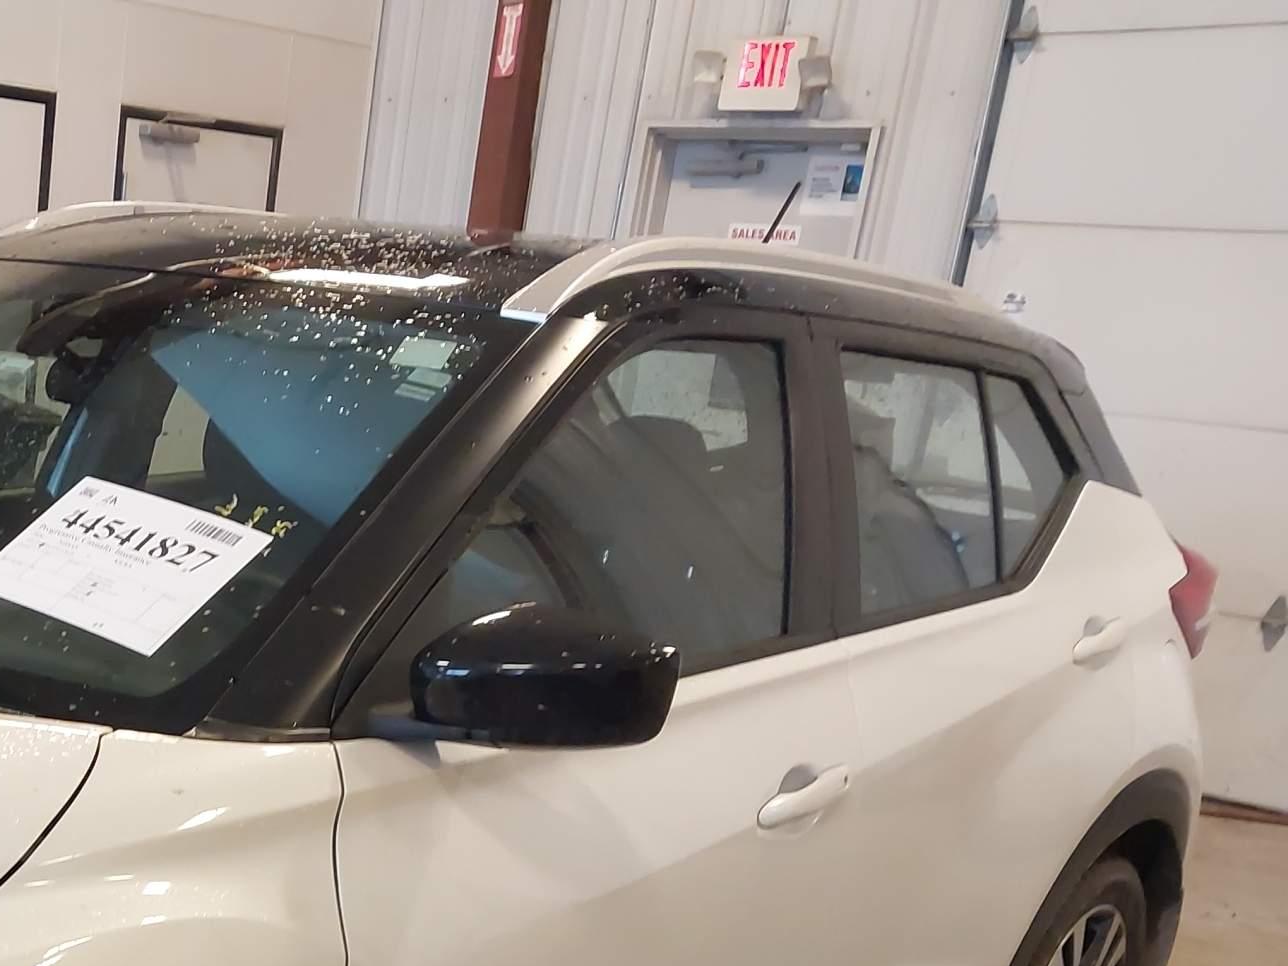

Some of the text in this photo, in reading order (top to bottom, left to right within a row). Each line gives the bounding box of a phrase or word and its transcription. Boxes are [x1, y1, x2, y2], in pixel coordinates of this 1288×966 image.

[737, 42, 796, 88] EXIT
[731, 228, 765, 240] SALES
[61, 509, 220, 573] 44541827
